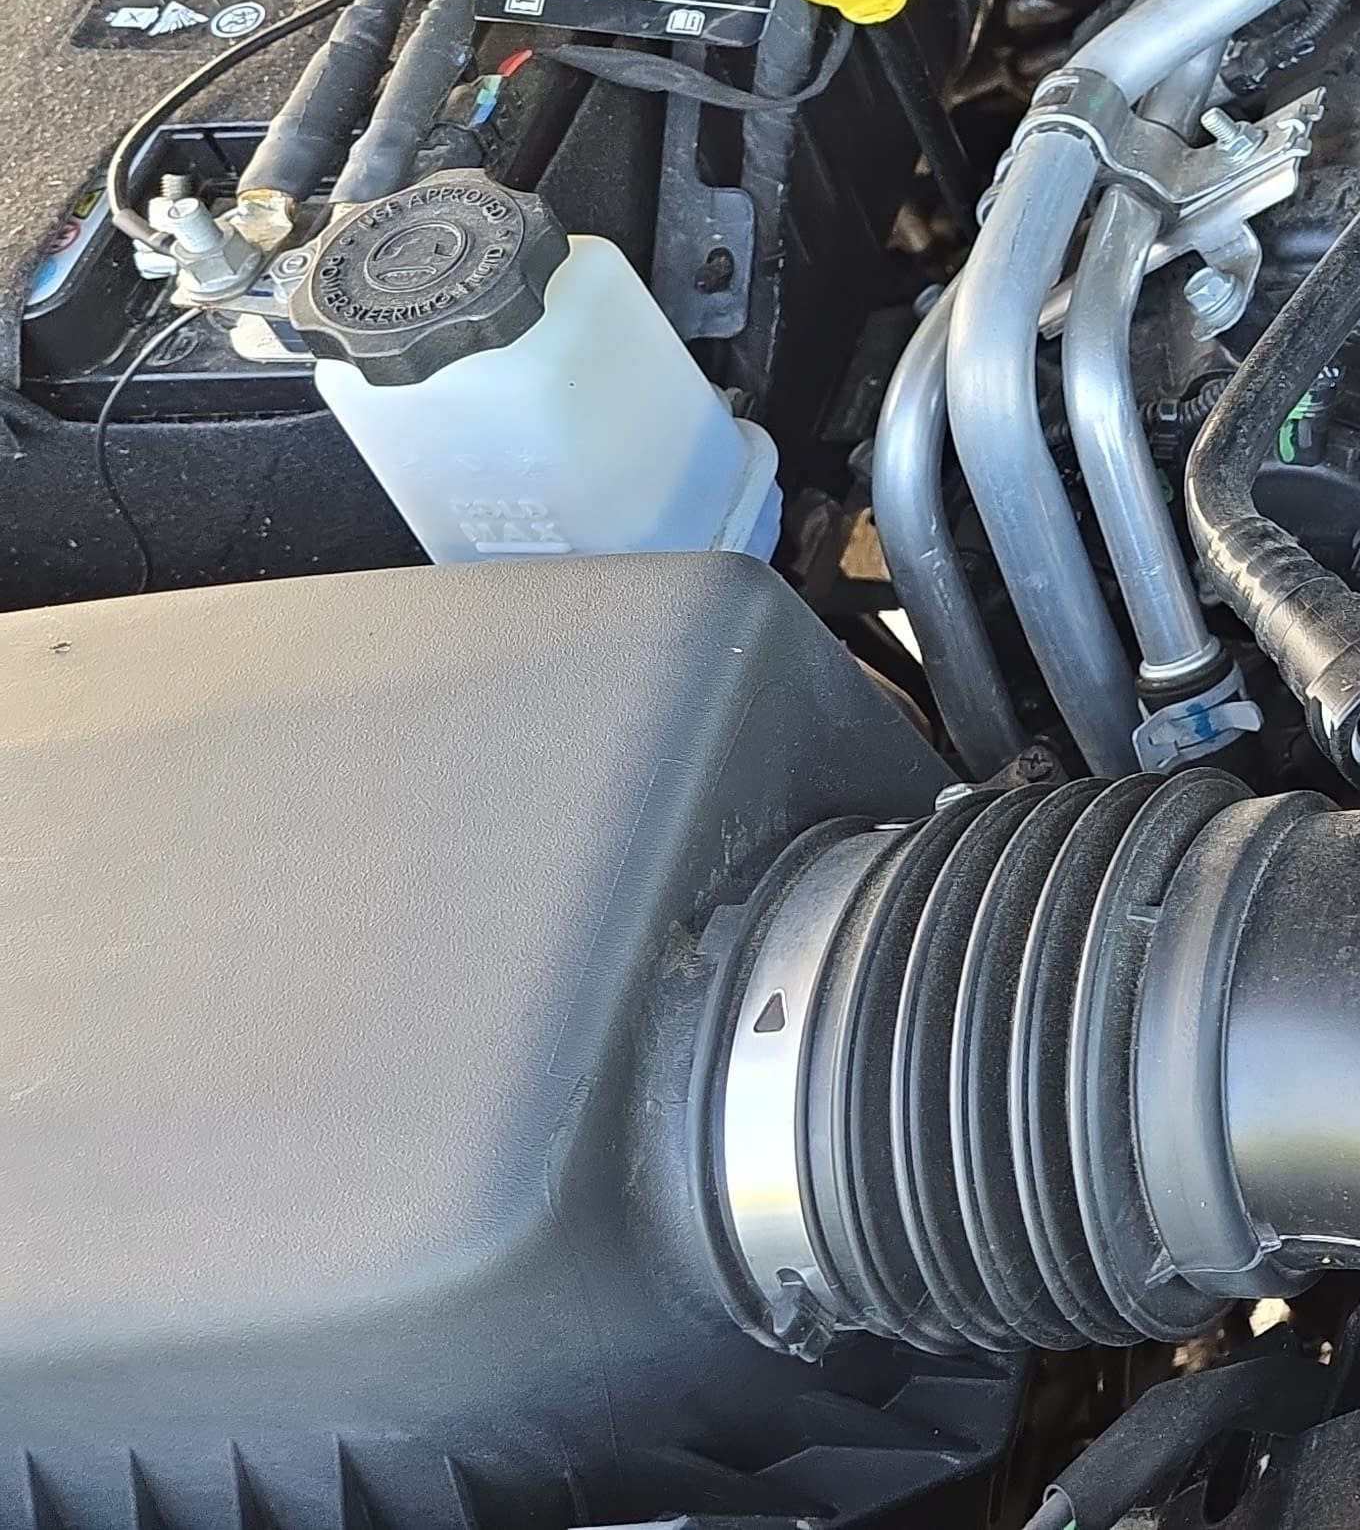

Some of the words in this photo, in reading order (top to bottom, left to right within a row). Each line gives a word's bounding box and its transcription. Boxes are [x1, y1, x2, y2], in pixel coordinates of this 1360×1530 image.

[357, 200, 402, 232] USE
[408, 187, 510, 225] APPROVED
[320, 255, 350, 313] POWER
[344, 291, 455, 325] STEERING
[453, 246, 505, 299] FLUID
